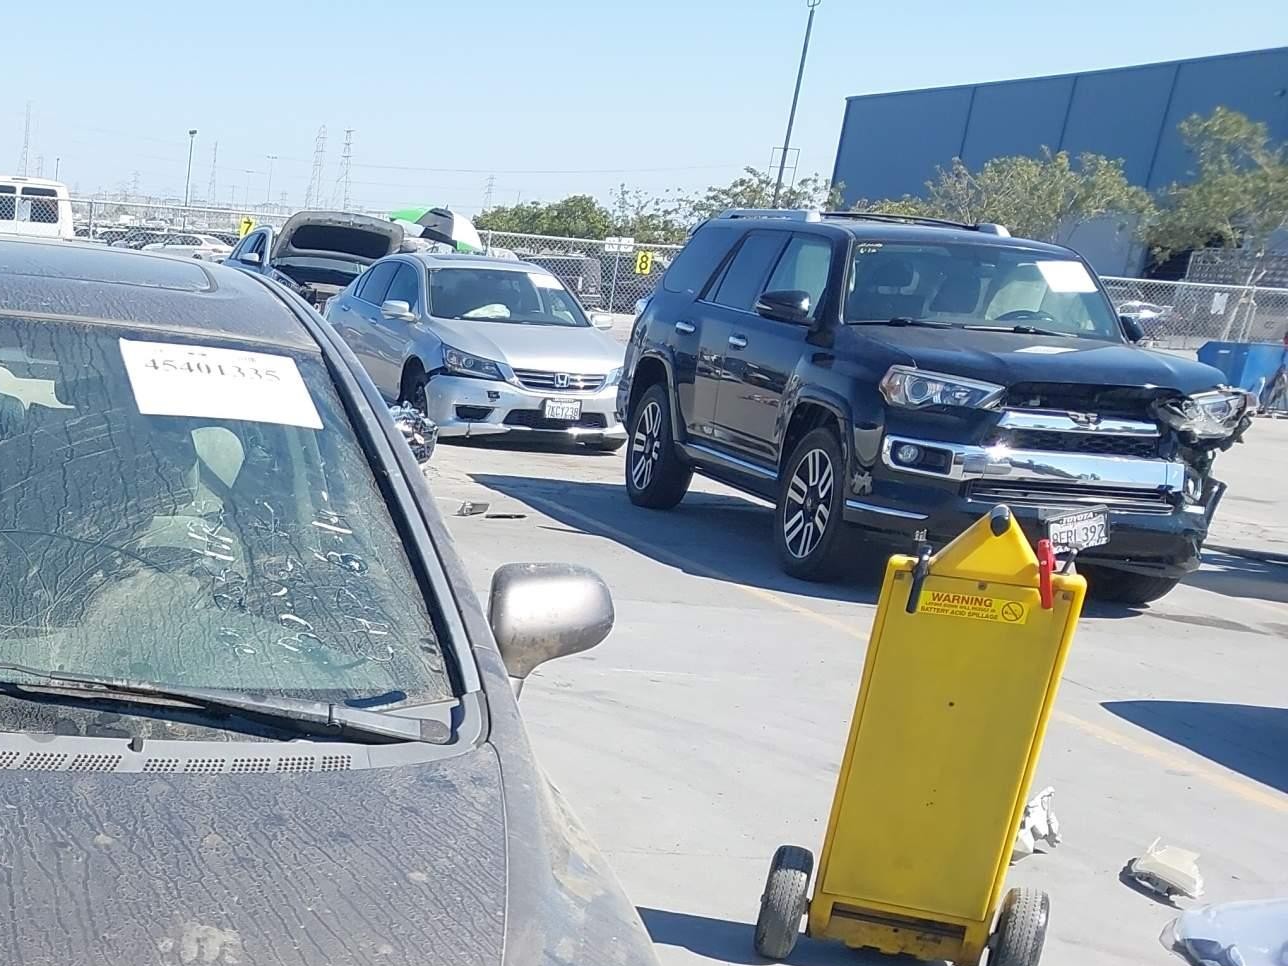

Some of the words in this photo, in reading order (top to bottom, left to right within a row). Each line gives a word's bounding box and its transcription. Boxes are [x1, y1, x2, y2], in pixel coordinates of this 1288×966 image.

[243, 220, 253, 235] 7
[638, 254, 649, 270] 8
[144, 357, 281, 385] 45401335
[1062, 511, 1094, 524] TOYOTA
[931, 592, 993, 608] WARNING
[920, 605, 948, 615] BATTERY
[950, 609, 967, 617] ACID
